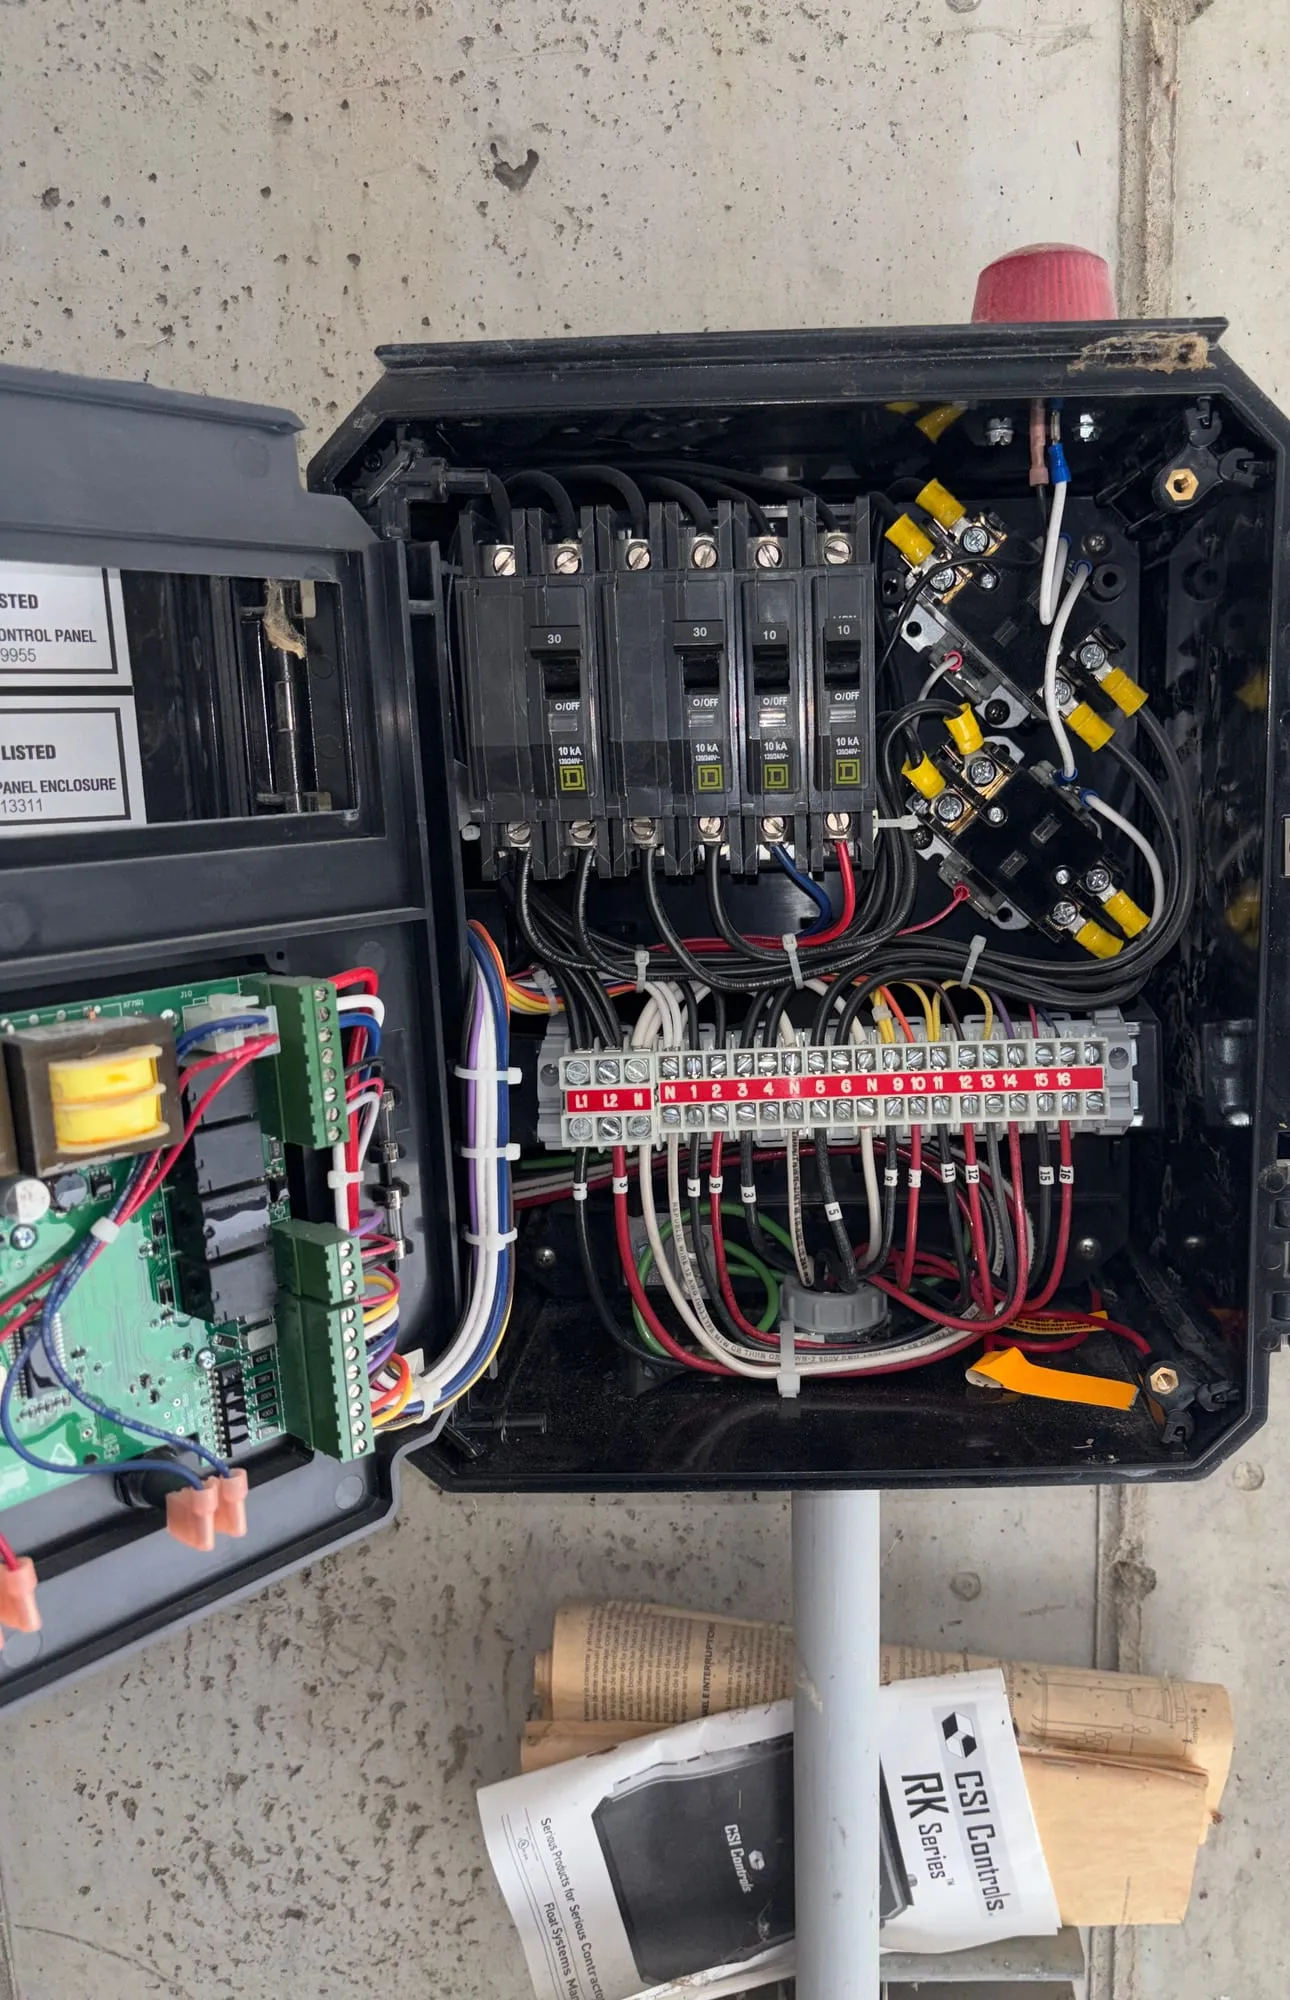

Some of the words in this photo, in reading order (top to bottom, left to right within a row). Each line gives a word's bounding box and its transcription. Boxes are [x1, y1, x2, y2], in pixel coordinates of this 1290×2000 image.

[55, 629, 97, 643] PANEL
[693, 627, 707, 637] 30
[763, 630, 777, 640] 10
[838, 625, 850, 635] 10
[548, 634, 561, 644] 30
[0, 648, 37, 663] 9955
[695, 743, 706, 752] 10
[707, 743, 718, 752] kA
[764, 742, 774, 750] 10
[775, 741, 787, 750] kA
[836, 737, 846, 746] 10
[847, 737, 859, 746] kA
[1, 744, 56, 760] LISTED
[558, 747, 568, 755] 10
[569, 746, 581, 755] kA
[40, 778, 117, 793] ENCLOSURE
[1, 798, 42, 813] 13311
[664, 1085, 676, 1099] N
[690, 1084, 697, 1099] 1
[712, 1084, 722, 1098] 2
[737, 1083, 748, 1097] 3
[763, 1082, 774, 1096] 4
[789, 1080, 800, 1094] N
[815, 1079, 826, 1094] 5
[841, 1079, 851, 1093] 6
[867, 1078, 878, 1092] N
[893, 1077, 904, 1092] 9
[910, 1076, 926, 1091] 10
[933, 1076, 943, 1090] 11
[959, 1075, 973, 1089] 12
[980, 1074, 995, 1089] 13
[1003, 1073, 1018, 1088] 14
[1034, 1073, 1049, 1087] 15
[1057, 1072, 1071, 1087] 16
[575, 1094, 588, 1108] L1
[603, 1093, 618, 1107] L2
[634, 1092, 643, 1107] N
[944, 1167, 954, 1178] 11
[968, 1169, 978, 1180] 12
[1040, 1171, 1051, 1181] 15
[1060, 1169, 1071, 1180] 16
[828, 1208, 839, 1216] 5
[901, 1772, 950, 1819] RK
[954, 1770, 990, 1816] CSI
[541, 1817, 558, 1852] Serious
[725, 1824, 742, 1846] CSI
[918, 1823, 946, 1879] Series
[552, 1851, 570, 1888] Products
[731, 1848, 754, 1894] Controls
[967, 1824, 1011, 1912] Controls
[564, 1888, 575, 1902] for
[569, 1904, 586, 1941] Serious
[544, 1902, 558, 1928] Float
[552, 1926, 572, 1976] Systems
